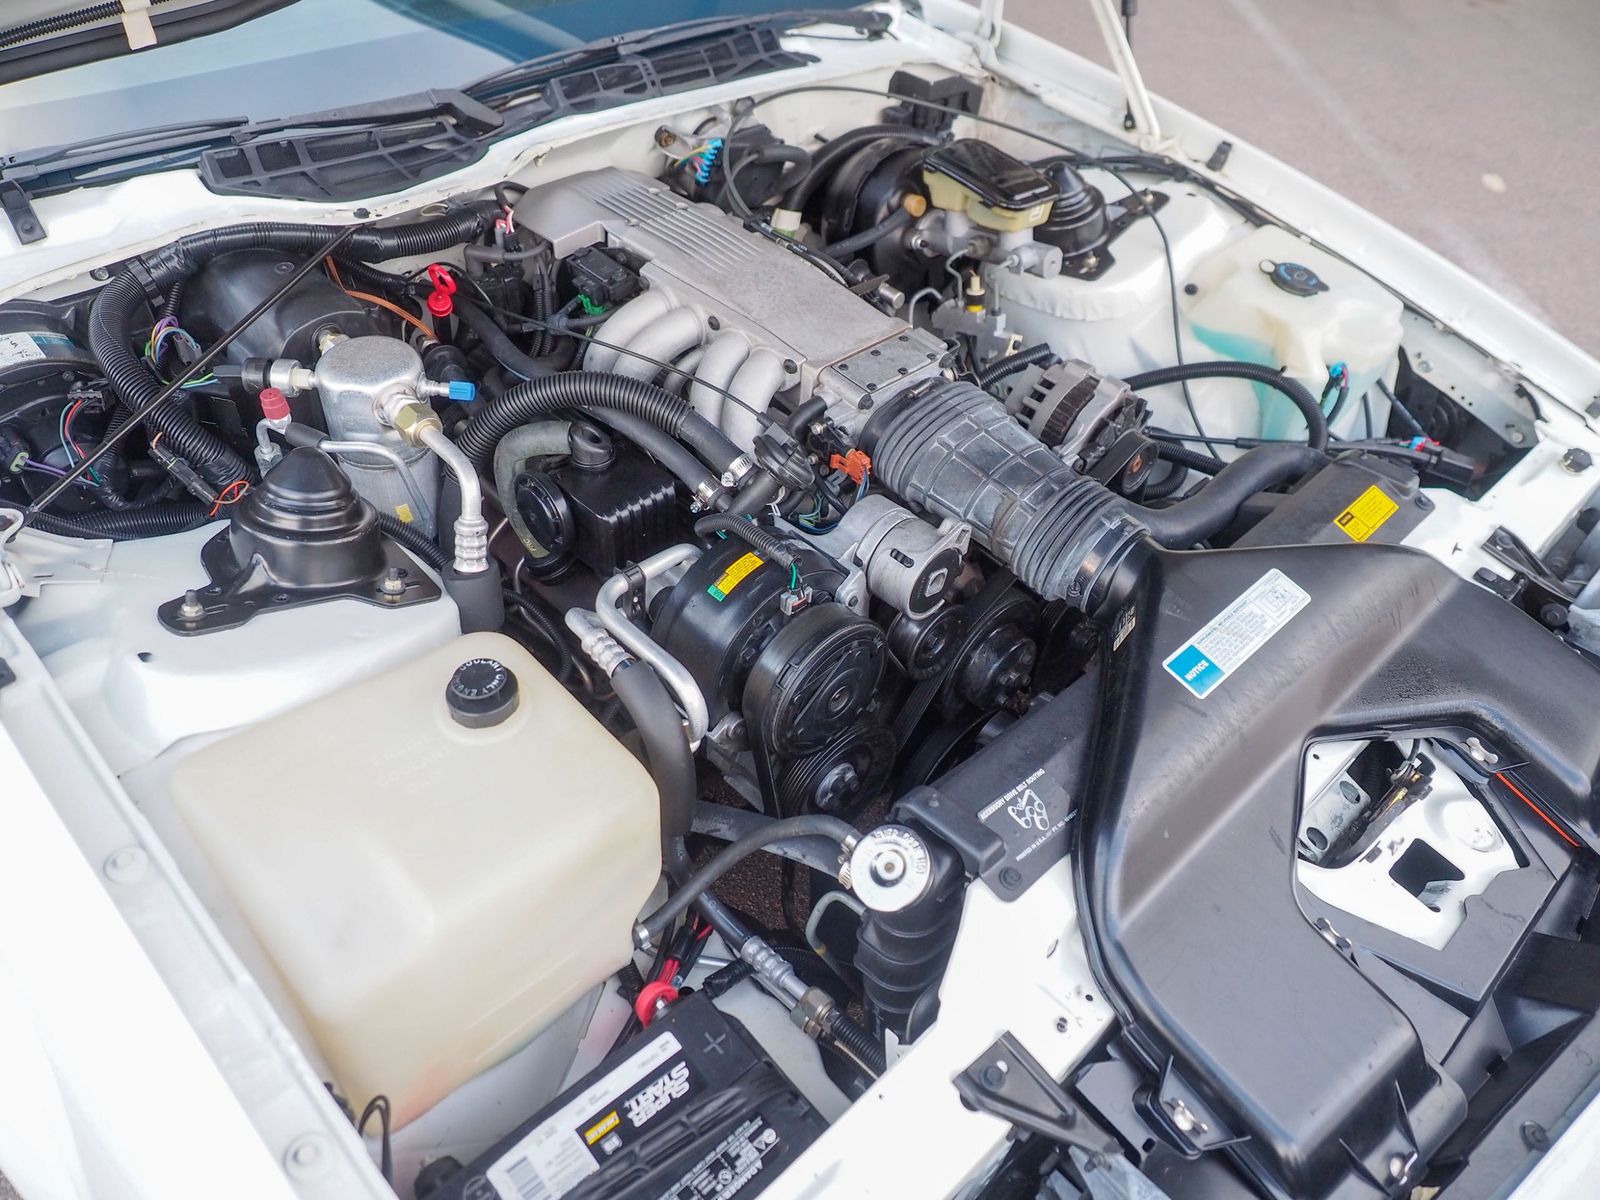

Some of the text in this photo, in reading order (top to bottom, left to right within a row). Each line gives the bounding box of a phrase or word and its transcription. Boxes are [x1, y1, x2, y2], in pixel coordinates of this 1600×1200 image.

[481, 673, 505, 696] ONLY
[1184, 659, 1209, 682] NOTICE
[980, 768, 1045, 821] ACCESSORY DRIVE BELT ROUTING
[624, 1061, 690, 1110] START
[627, 1081, 690, 1128] SUPER
